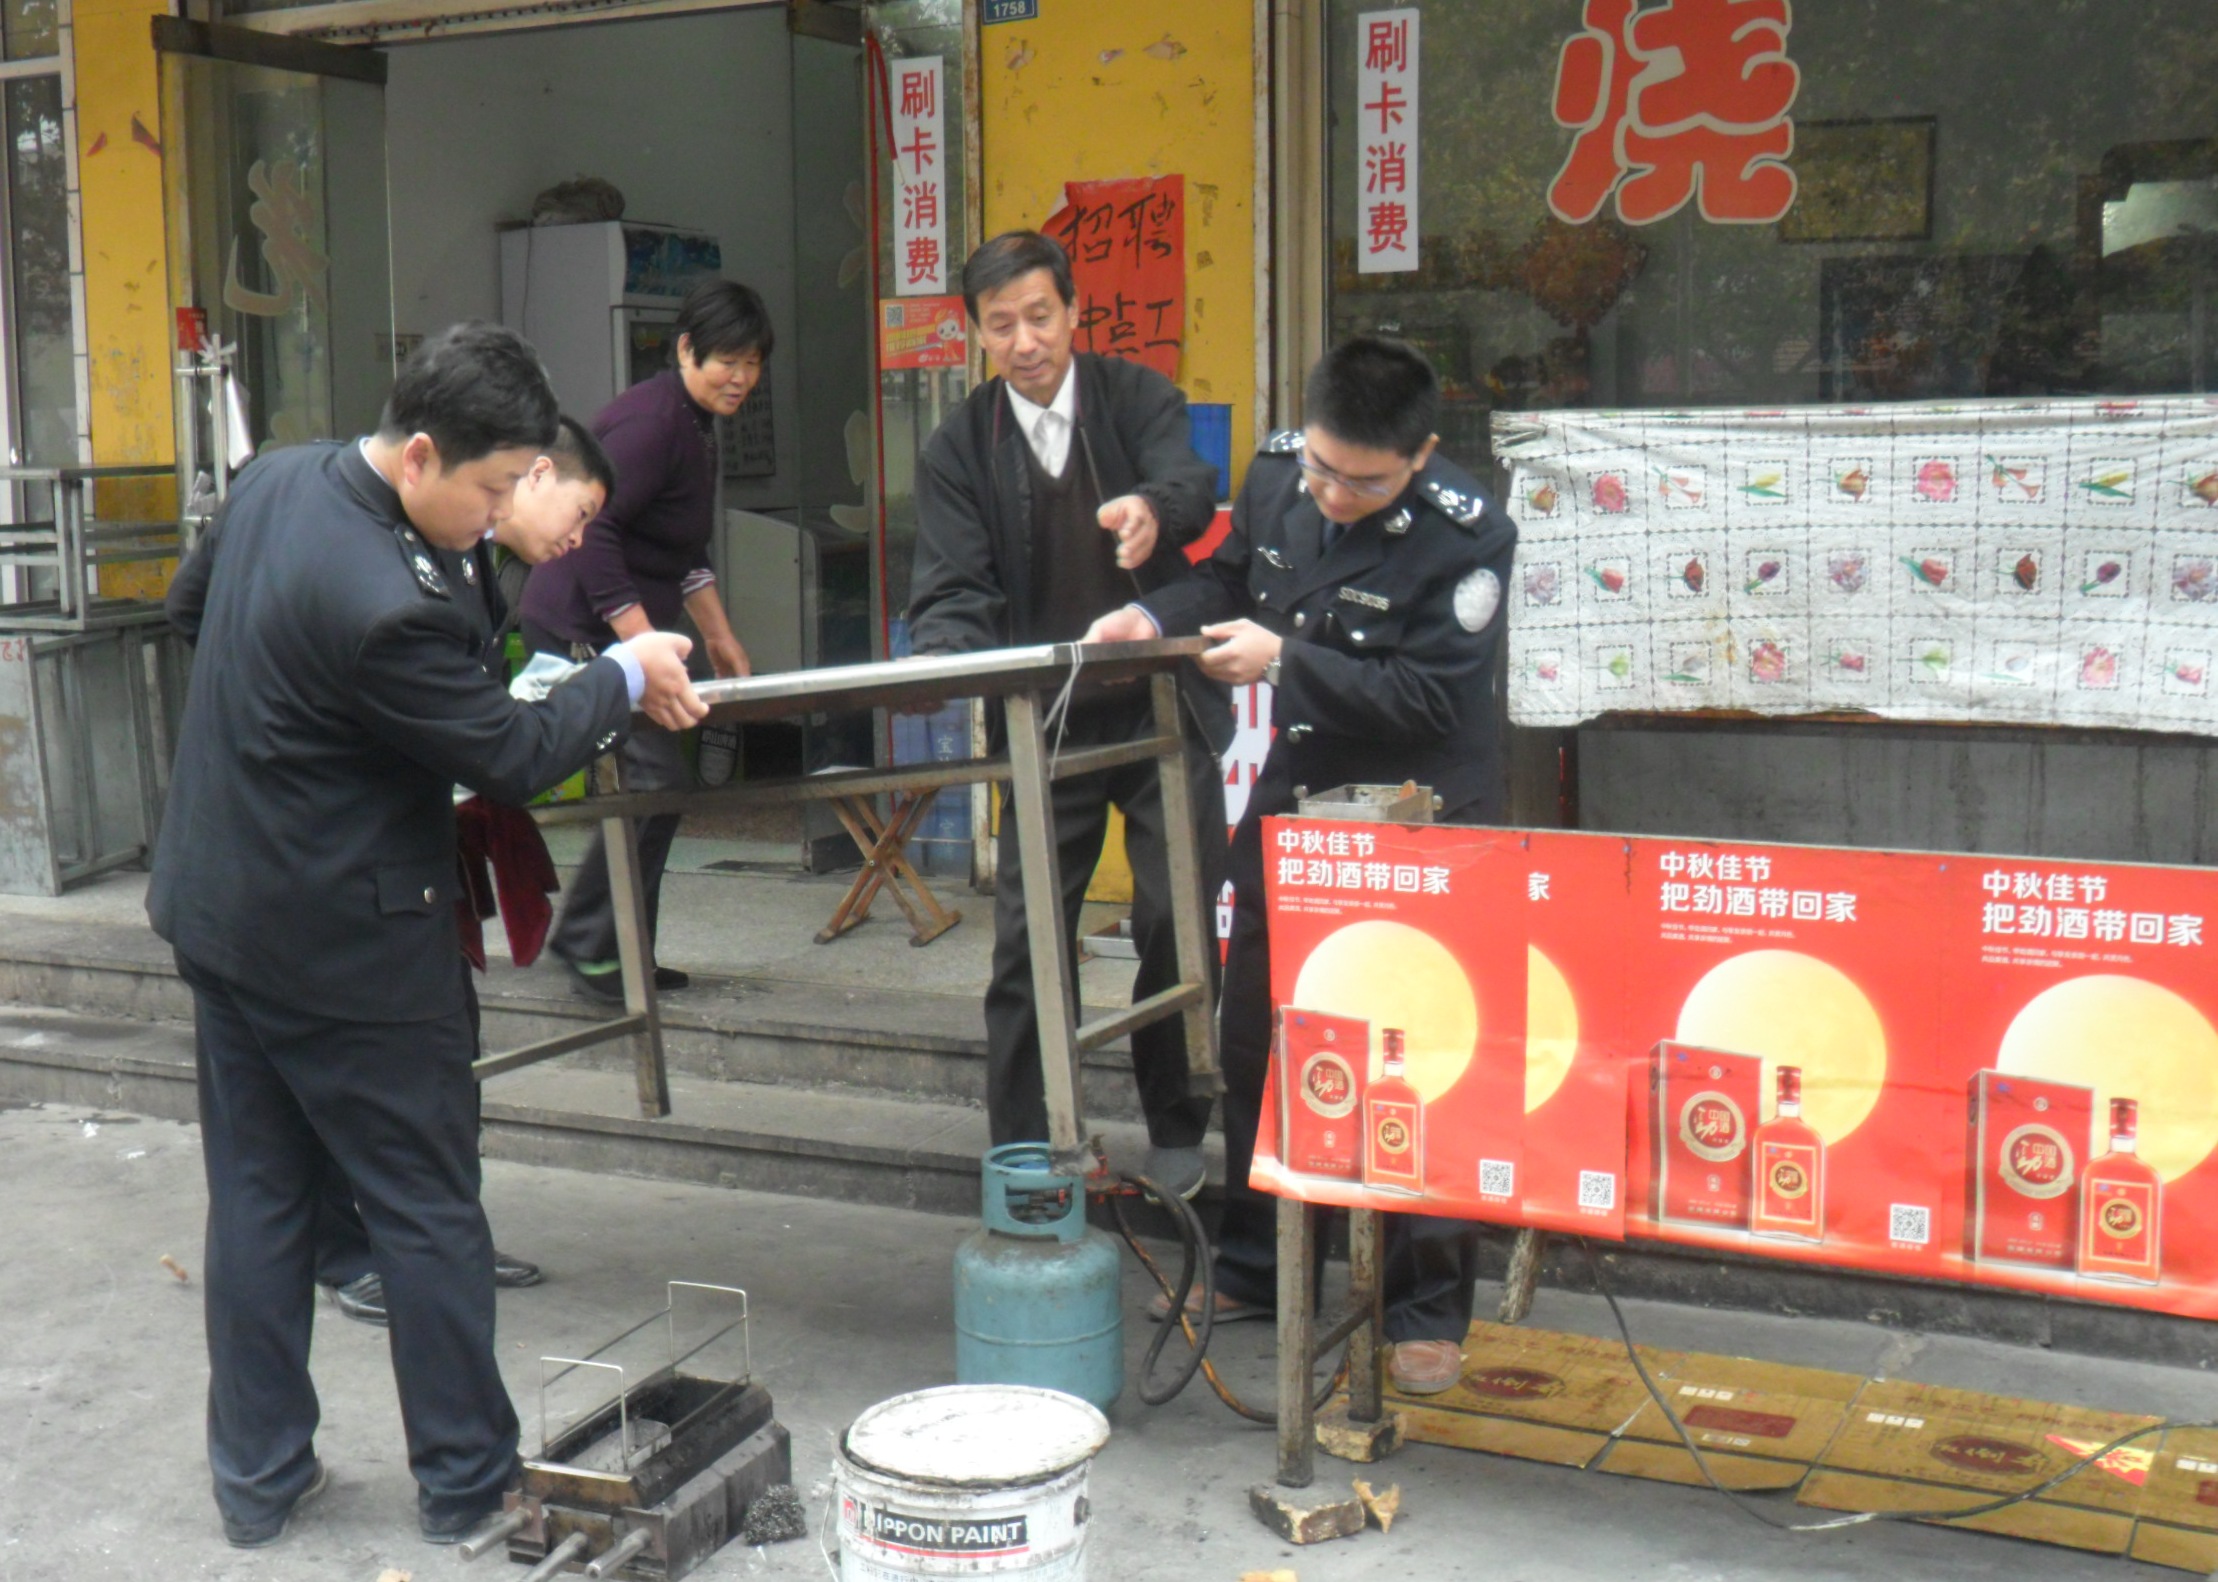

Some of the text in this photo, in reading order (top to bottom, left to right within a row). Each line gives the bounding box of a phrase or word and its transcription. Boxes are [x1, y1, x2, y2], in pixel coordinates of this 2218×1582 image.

[994, 0, 1026, 18] 1758
[1547, 0, 1801, 226] 烧
[1364, 19, 1410, 255] 刷卡消费
[899, 68, 942, 286] 刷卡消费
[1058, 193, 1176, 270] 招聘
[1277, 828, 1376, 858] 中秋佳节
[1277, 857, 1451, 895] 把劲酒带回家
[1659, 850, 1772, 883] 中秋佳节
[1528, 871, 1552, 902] 家
[1659, 882, 1858, 924] 把劲酒带回家
[1982, 869, 2109, 904] 中秋佳节
[1982, 902, 2205, 947] 把劲酒带回家
[870, 1512, 1023, 1545] IPPON PAINT
